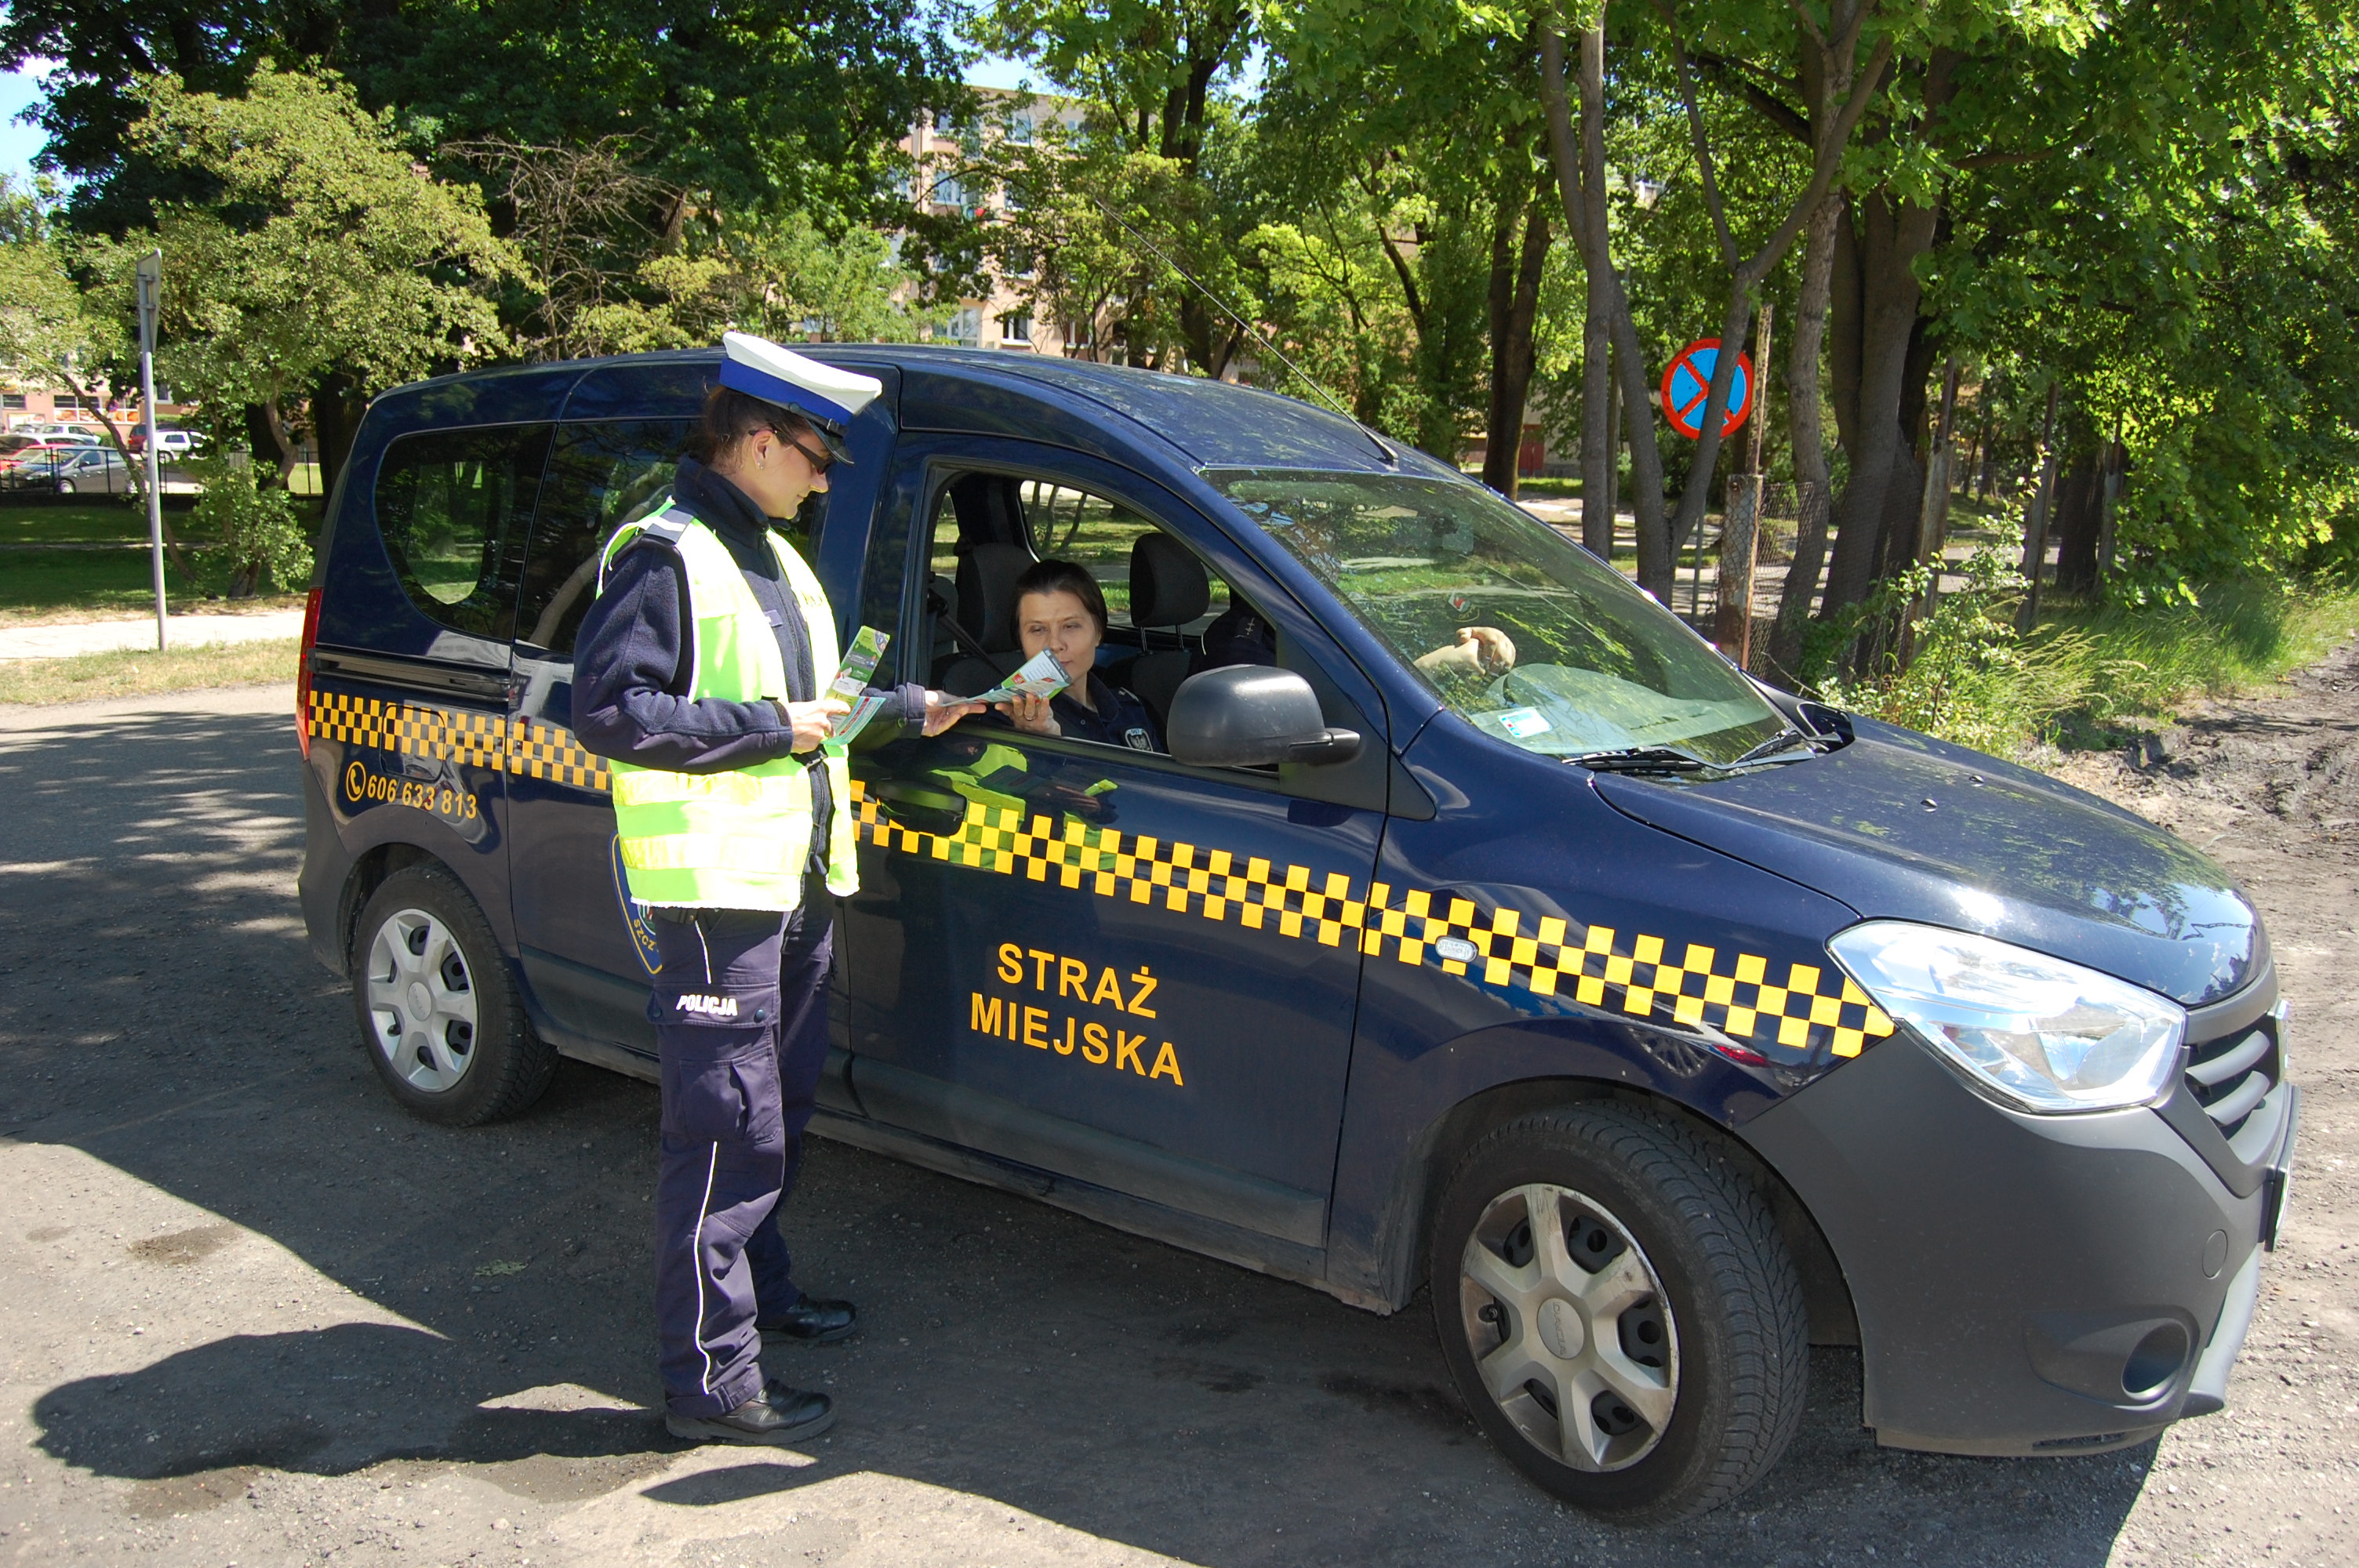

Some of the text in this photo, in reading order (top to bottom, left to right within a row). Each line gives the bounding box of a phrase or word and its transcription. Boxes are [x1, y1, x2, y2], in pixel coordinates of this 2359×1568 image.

[368, 775, 476, 819] 606 633 813
[675, 994, 738, 1016] POLICJA
[998, 942, 1158, 1018] STRAŻ
[970, 993, 1183, 1087] MIEJSKA
